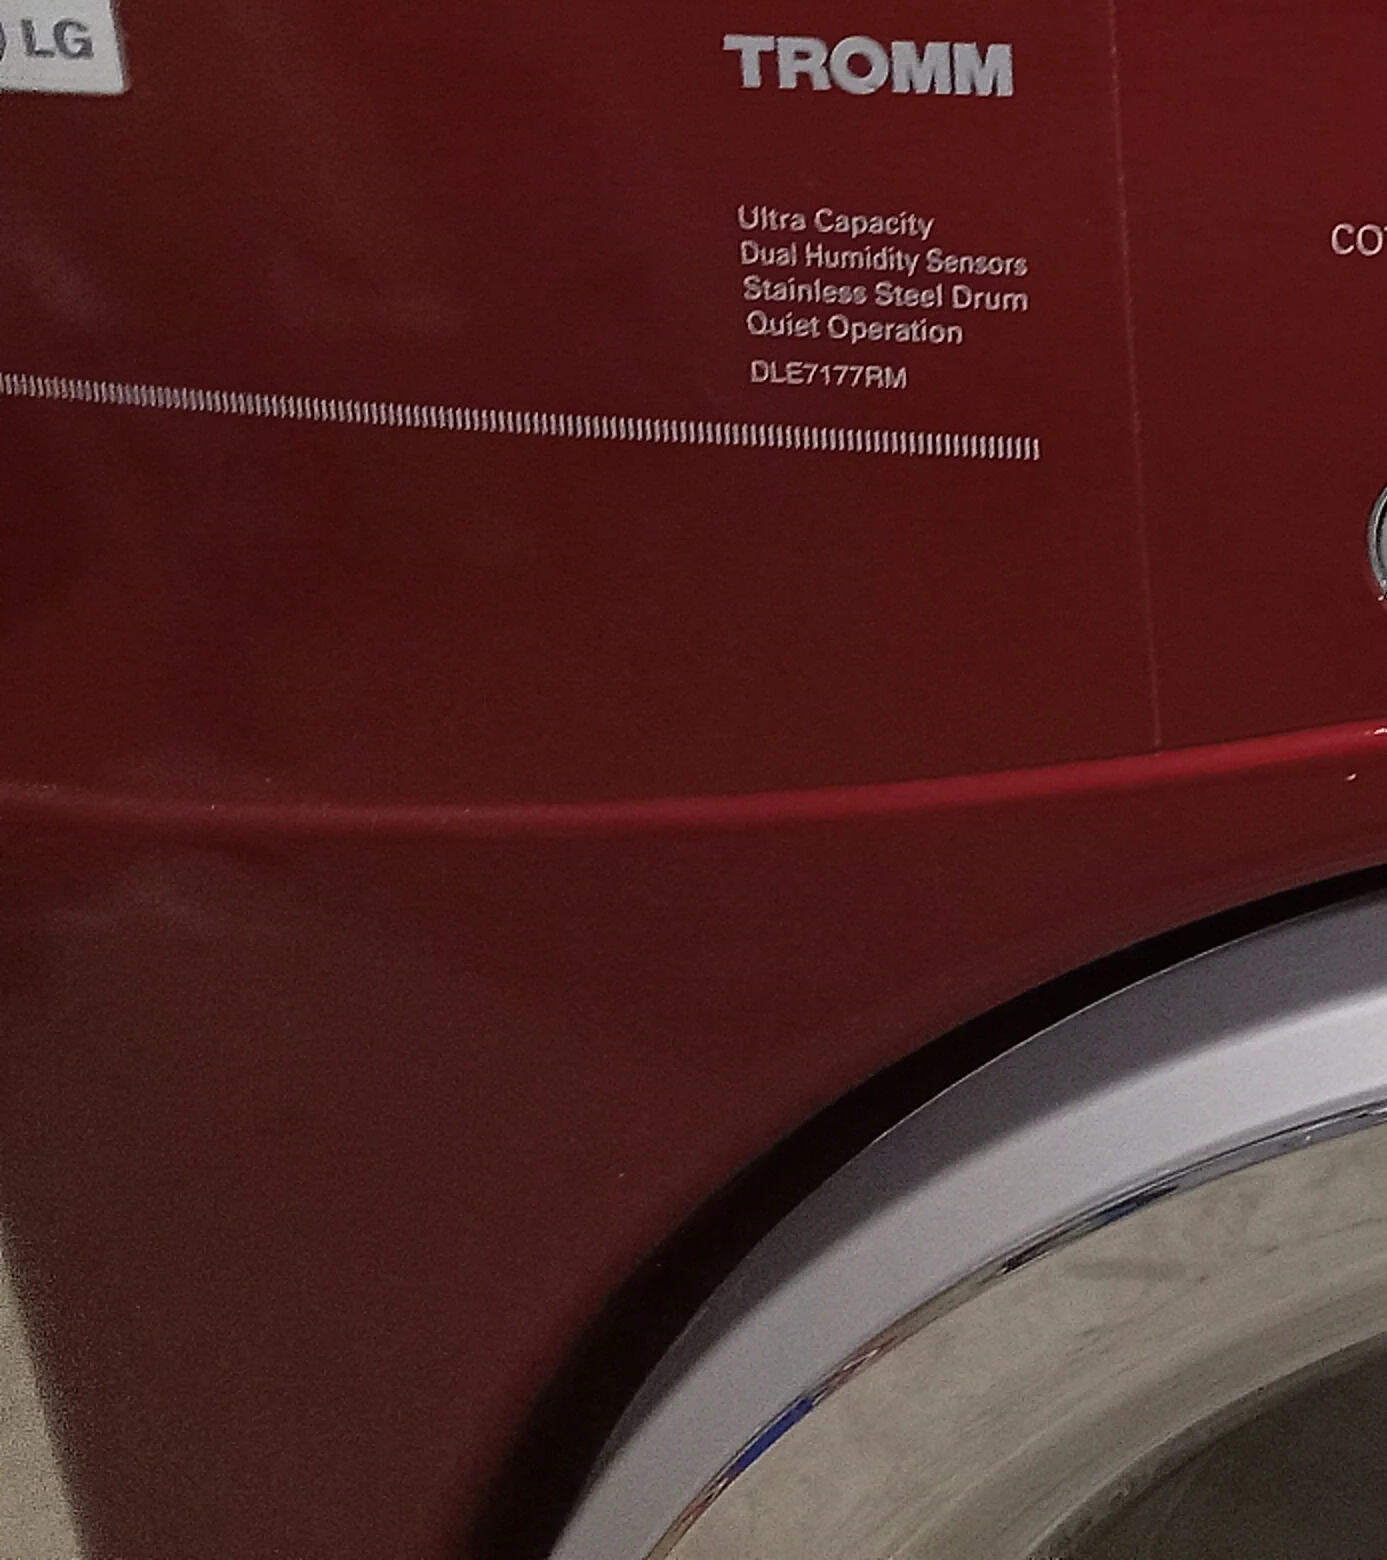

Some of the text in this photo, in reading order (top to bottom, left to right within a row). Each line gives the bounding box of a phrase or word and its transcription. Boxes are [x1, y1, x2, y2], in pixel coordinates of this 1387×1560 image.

[19, 16, 96, 60] LG
[723, 34, 1014, 97] TROMM
[737, 205, 935, 241] Ultra Capacity
[740, 240, 1028, 277] Dual Humidity Sensors
[743, 274, 1028, 311] Stainless Steel Drum
[746, 309, 963, 345] Quiet Operation
[750, 359, 907, 389] DLE7177RM
